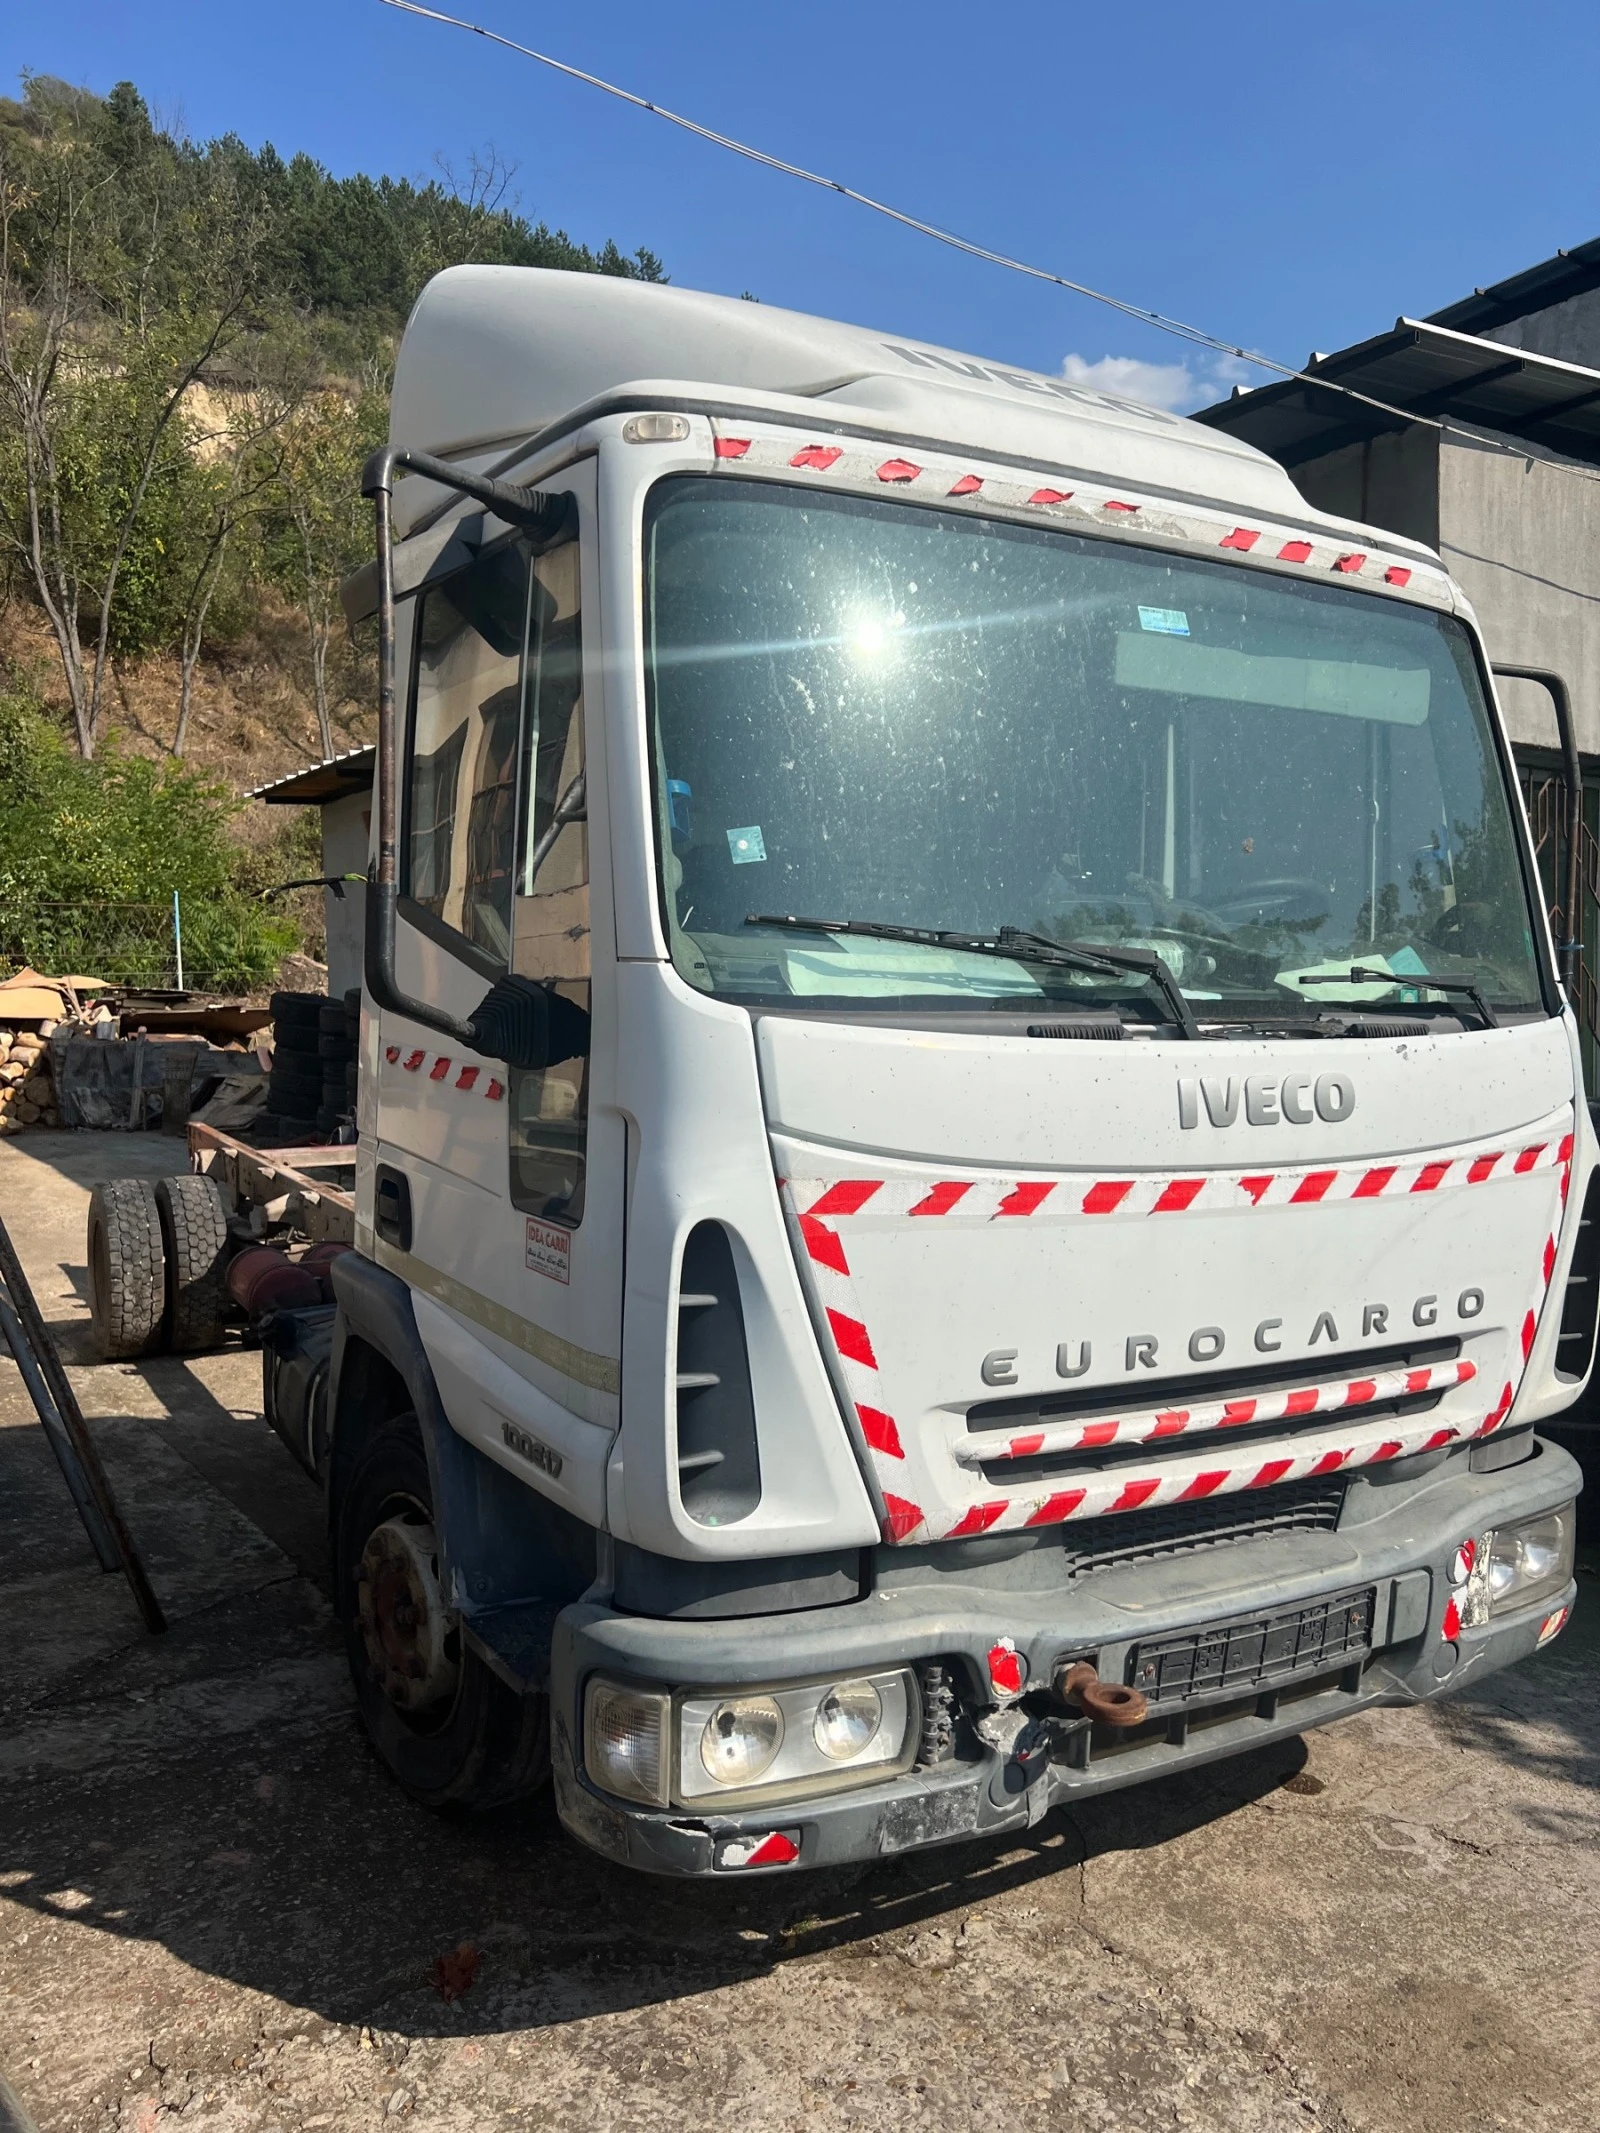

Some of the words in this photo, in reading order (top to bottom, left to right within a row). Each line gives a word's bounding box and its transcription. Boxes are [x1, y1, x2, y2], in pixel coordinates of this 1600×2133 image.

[880, 343, 1178, 425] IVECO
[1177, 1072, 1356, 1130] IVECO
[528, 1225, 545, 1246] IDEA
[980, 1287, 1485, 1387] EUROCARGO
